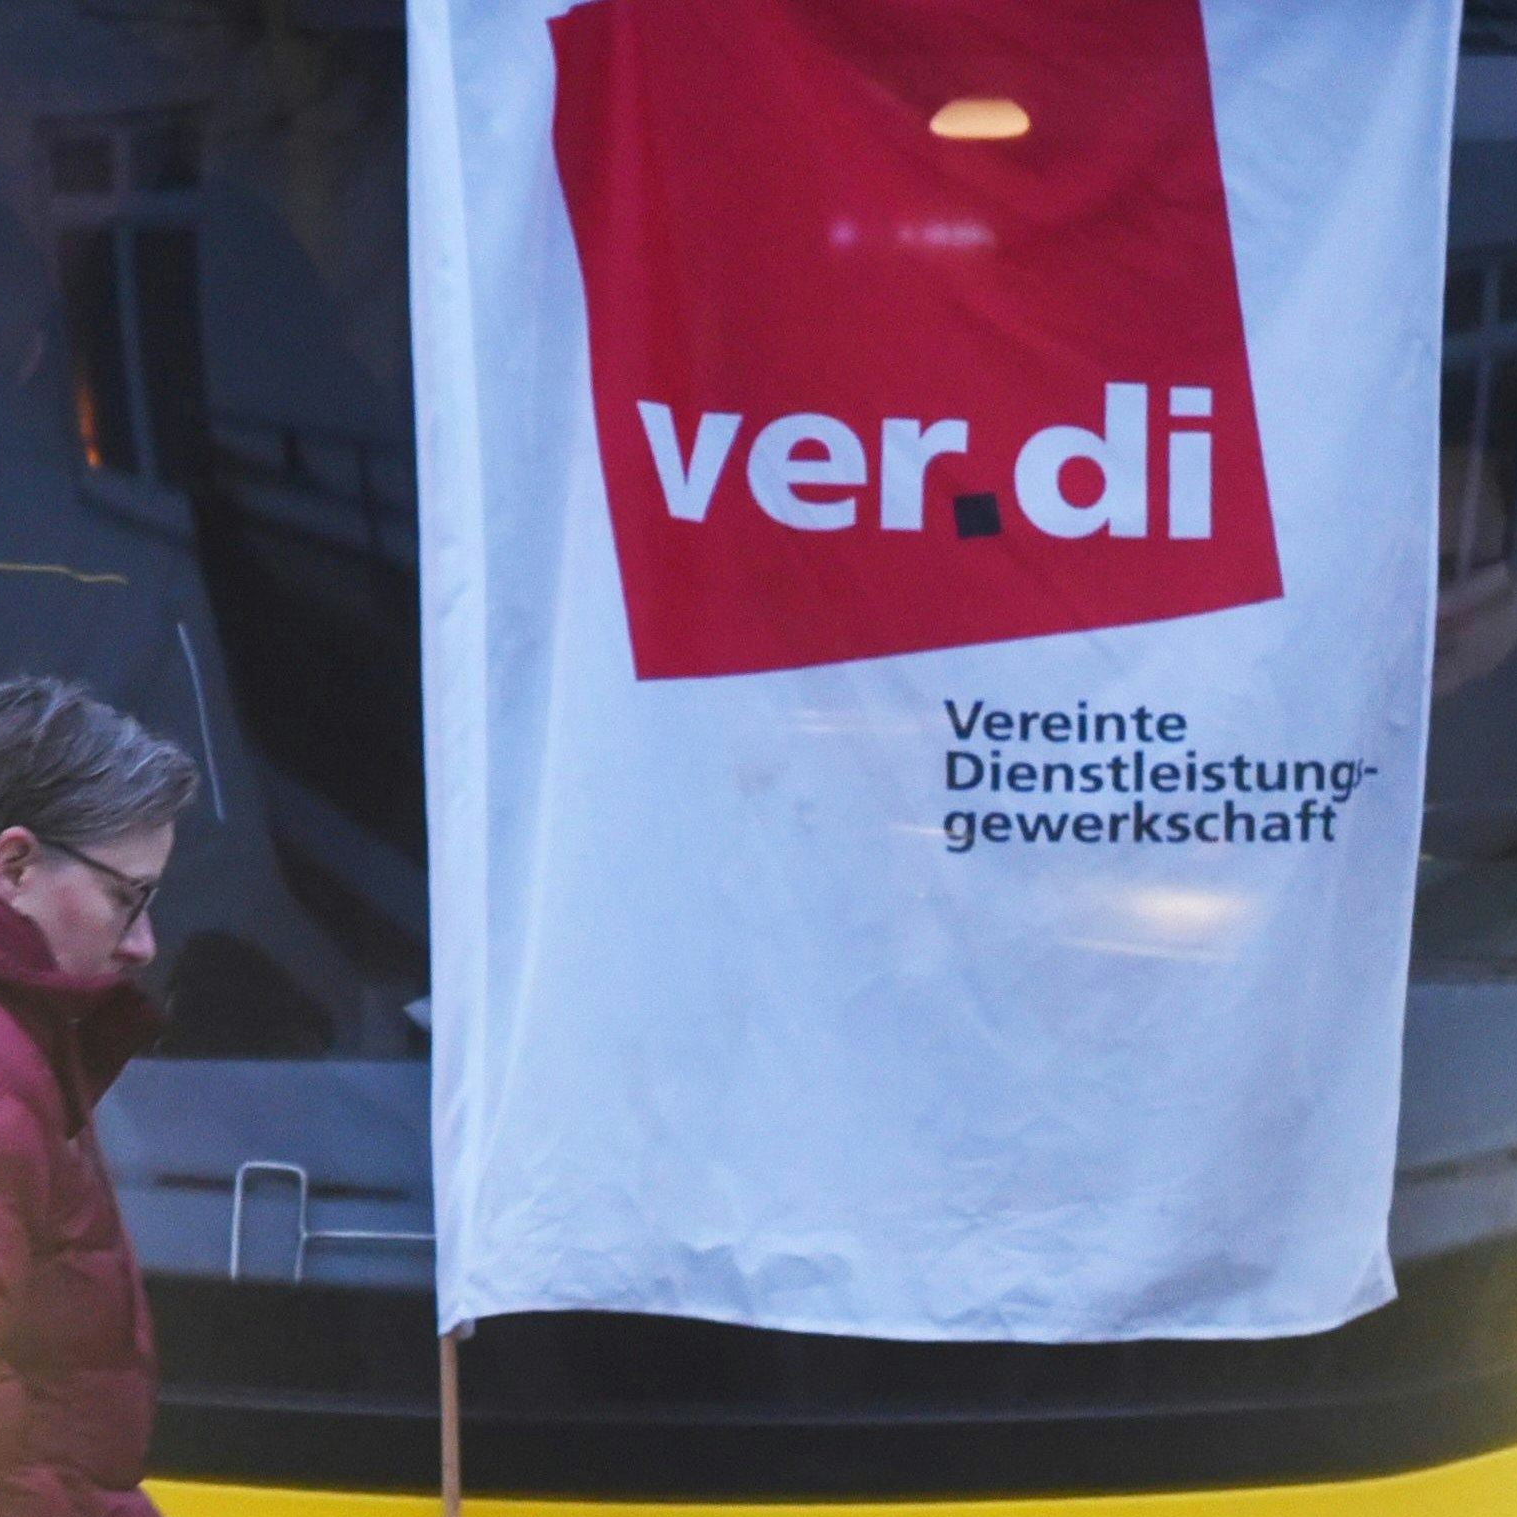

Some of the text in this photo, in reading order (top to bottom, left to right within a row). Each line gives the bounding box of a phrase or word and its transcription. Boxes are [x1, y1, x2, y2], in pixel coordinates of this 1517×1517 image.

[636, 381, 1213, 541] ver.di
[943, 699, 1188, 743] Vereinte
[942, 799, 1338, 854] gewerkschaft
